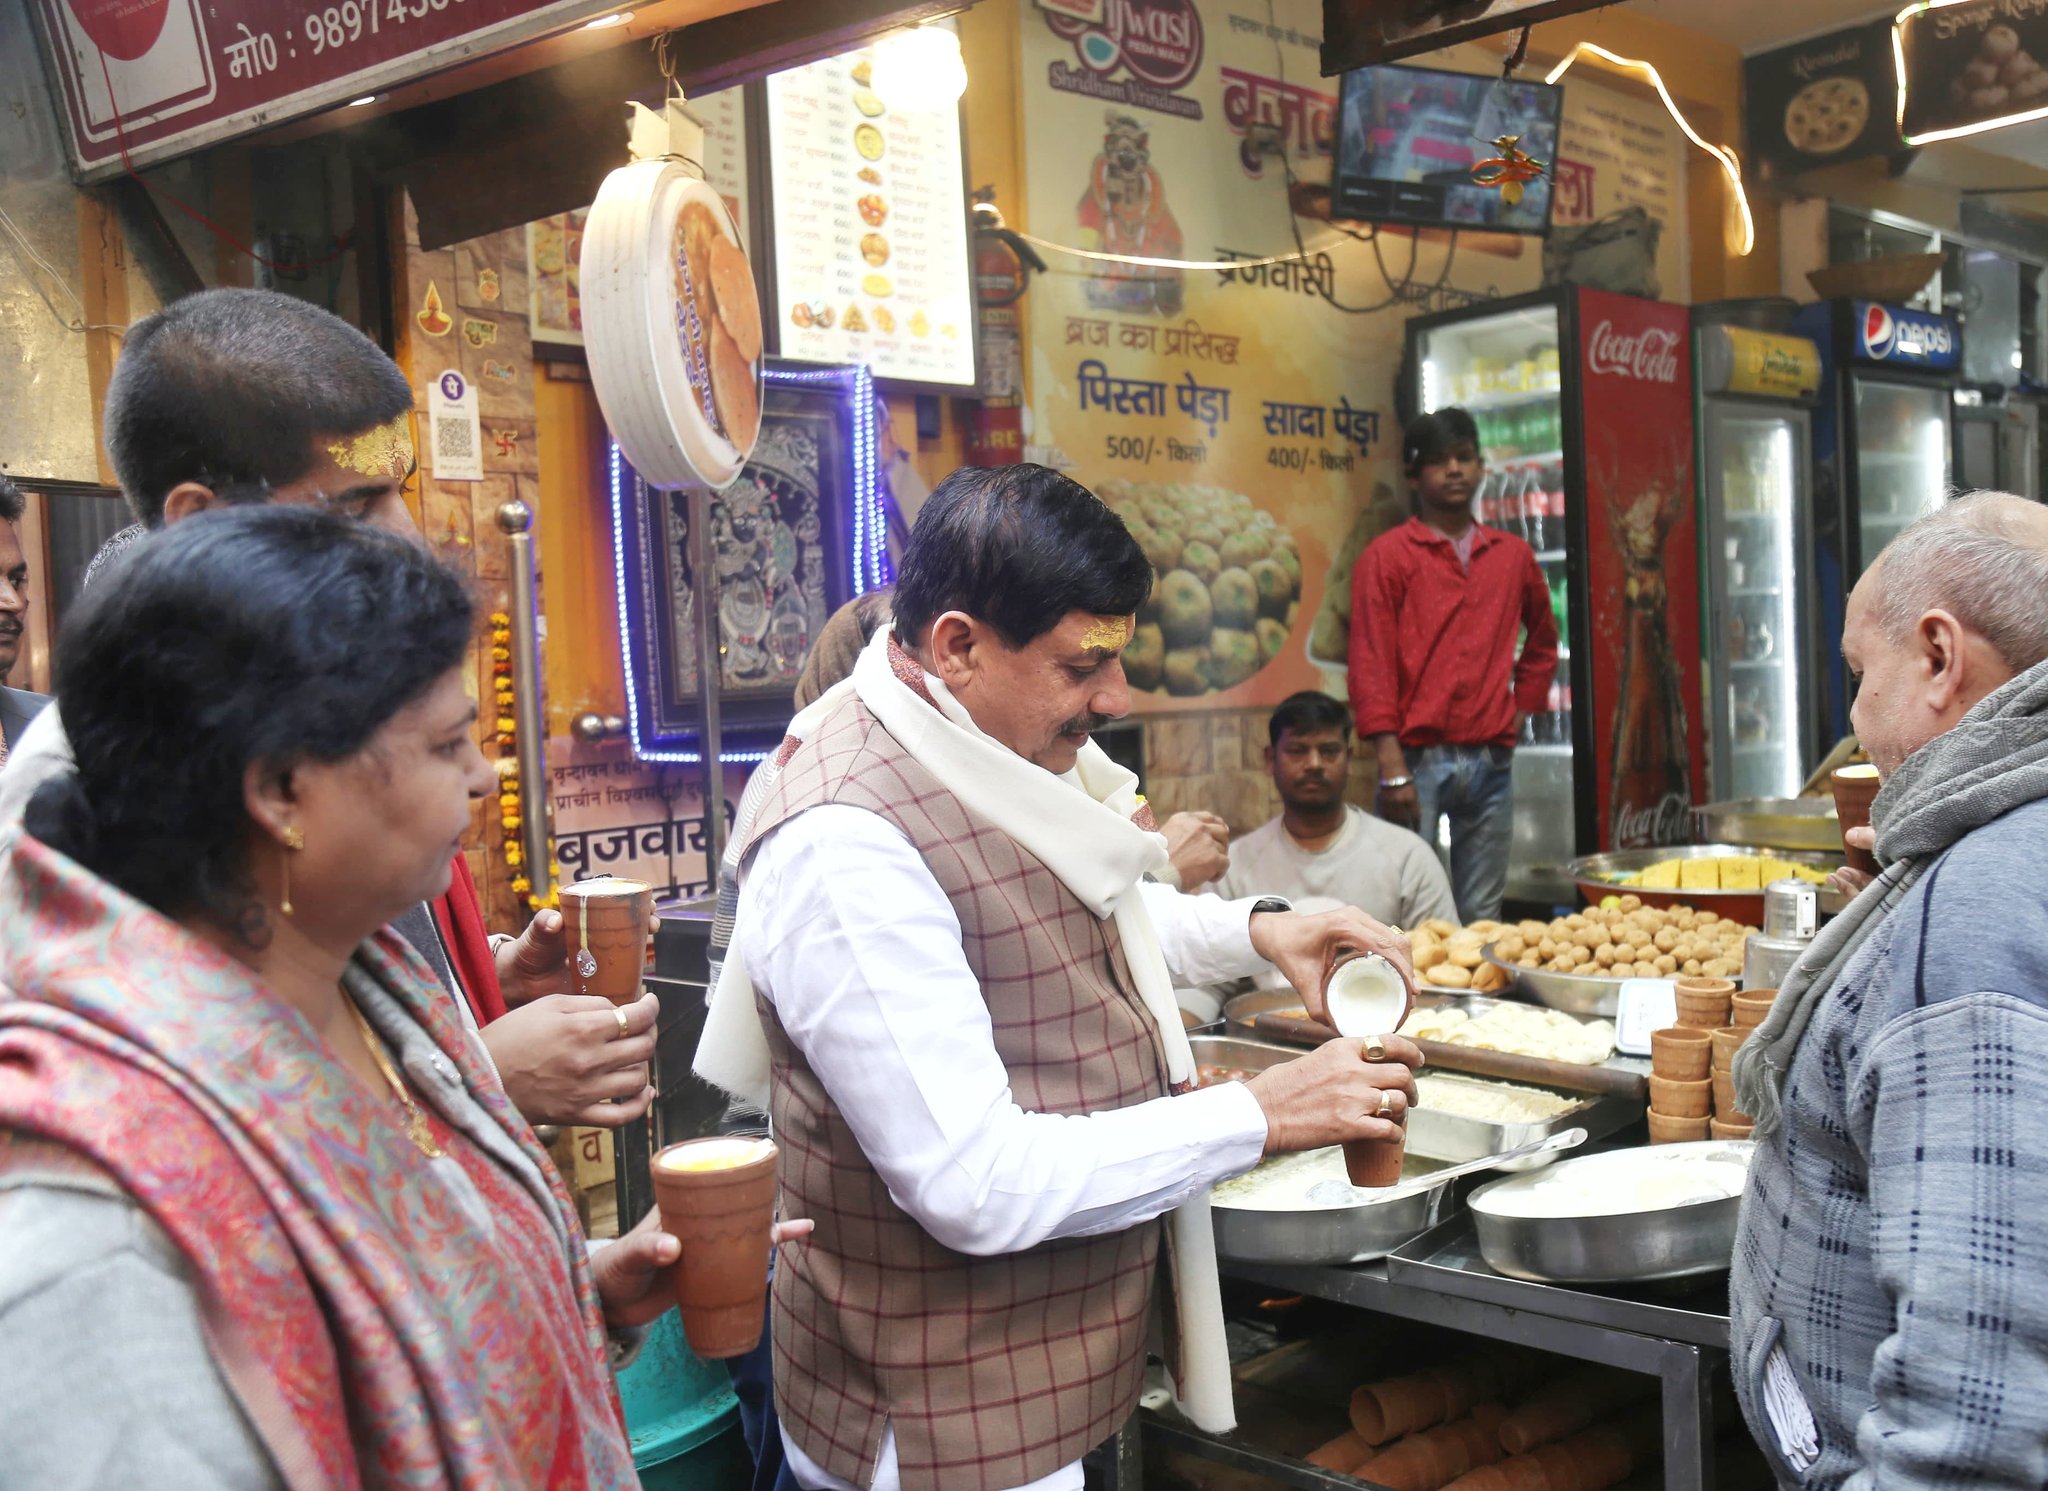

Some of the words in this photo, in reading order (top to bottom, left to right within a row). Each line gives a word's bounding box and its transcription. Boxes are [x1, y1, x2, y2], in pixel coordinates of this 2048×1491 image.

[304, 0, 466, 55] 98974
[1066, 316, 1111, 348] ब्रज
[1119, 322, 1159, 354] का
[1077, 359, 1168, 418] पिस्ता
[1176, 371, 1231, 439] पेड़ा
[1262, 401, 1327, 439] सादा
[1332, 394, 1380, 458] पेड़ा
[553, 762, 609, 787] वृन्दावन
[556, 788, 601, 811] प्राचीन
